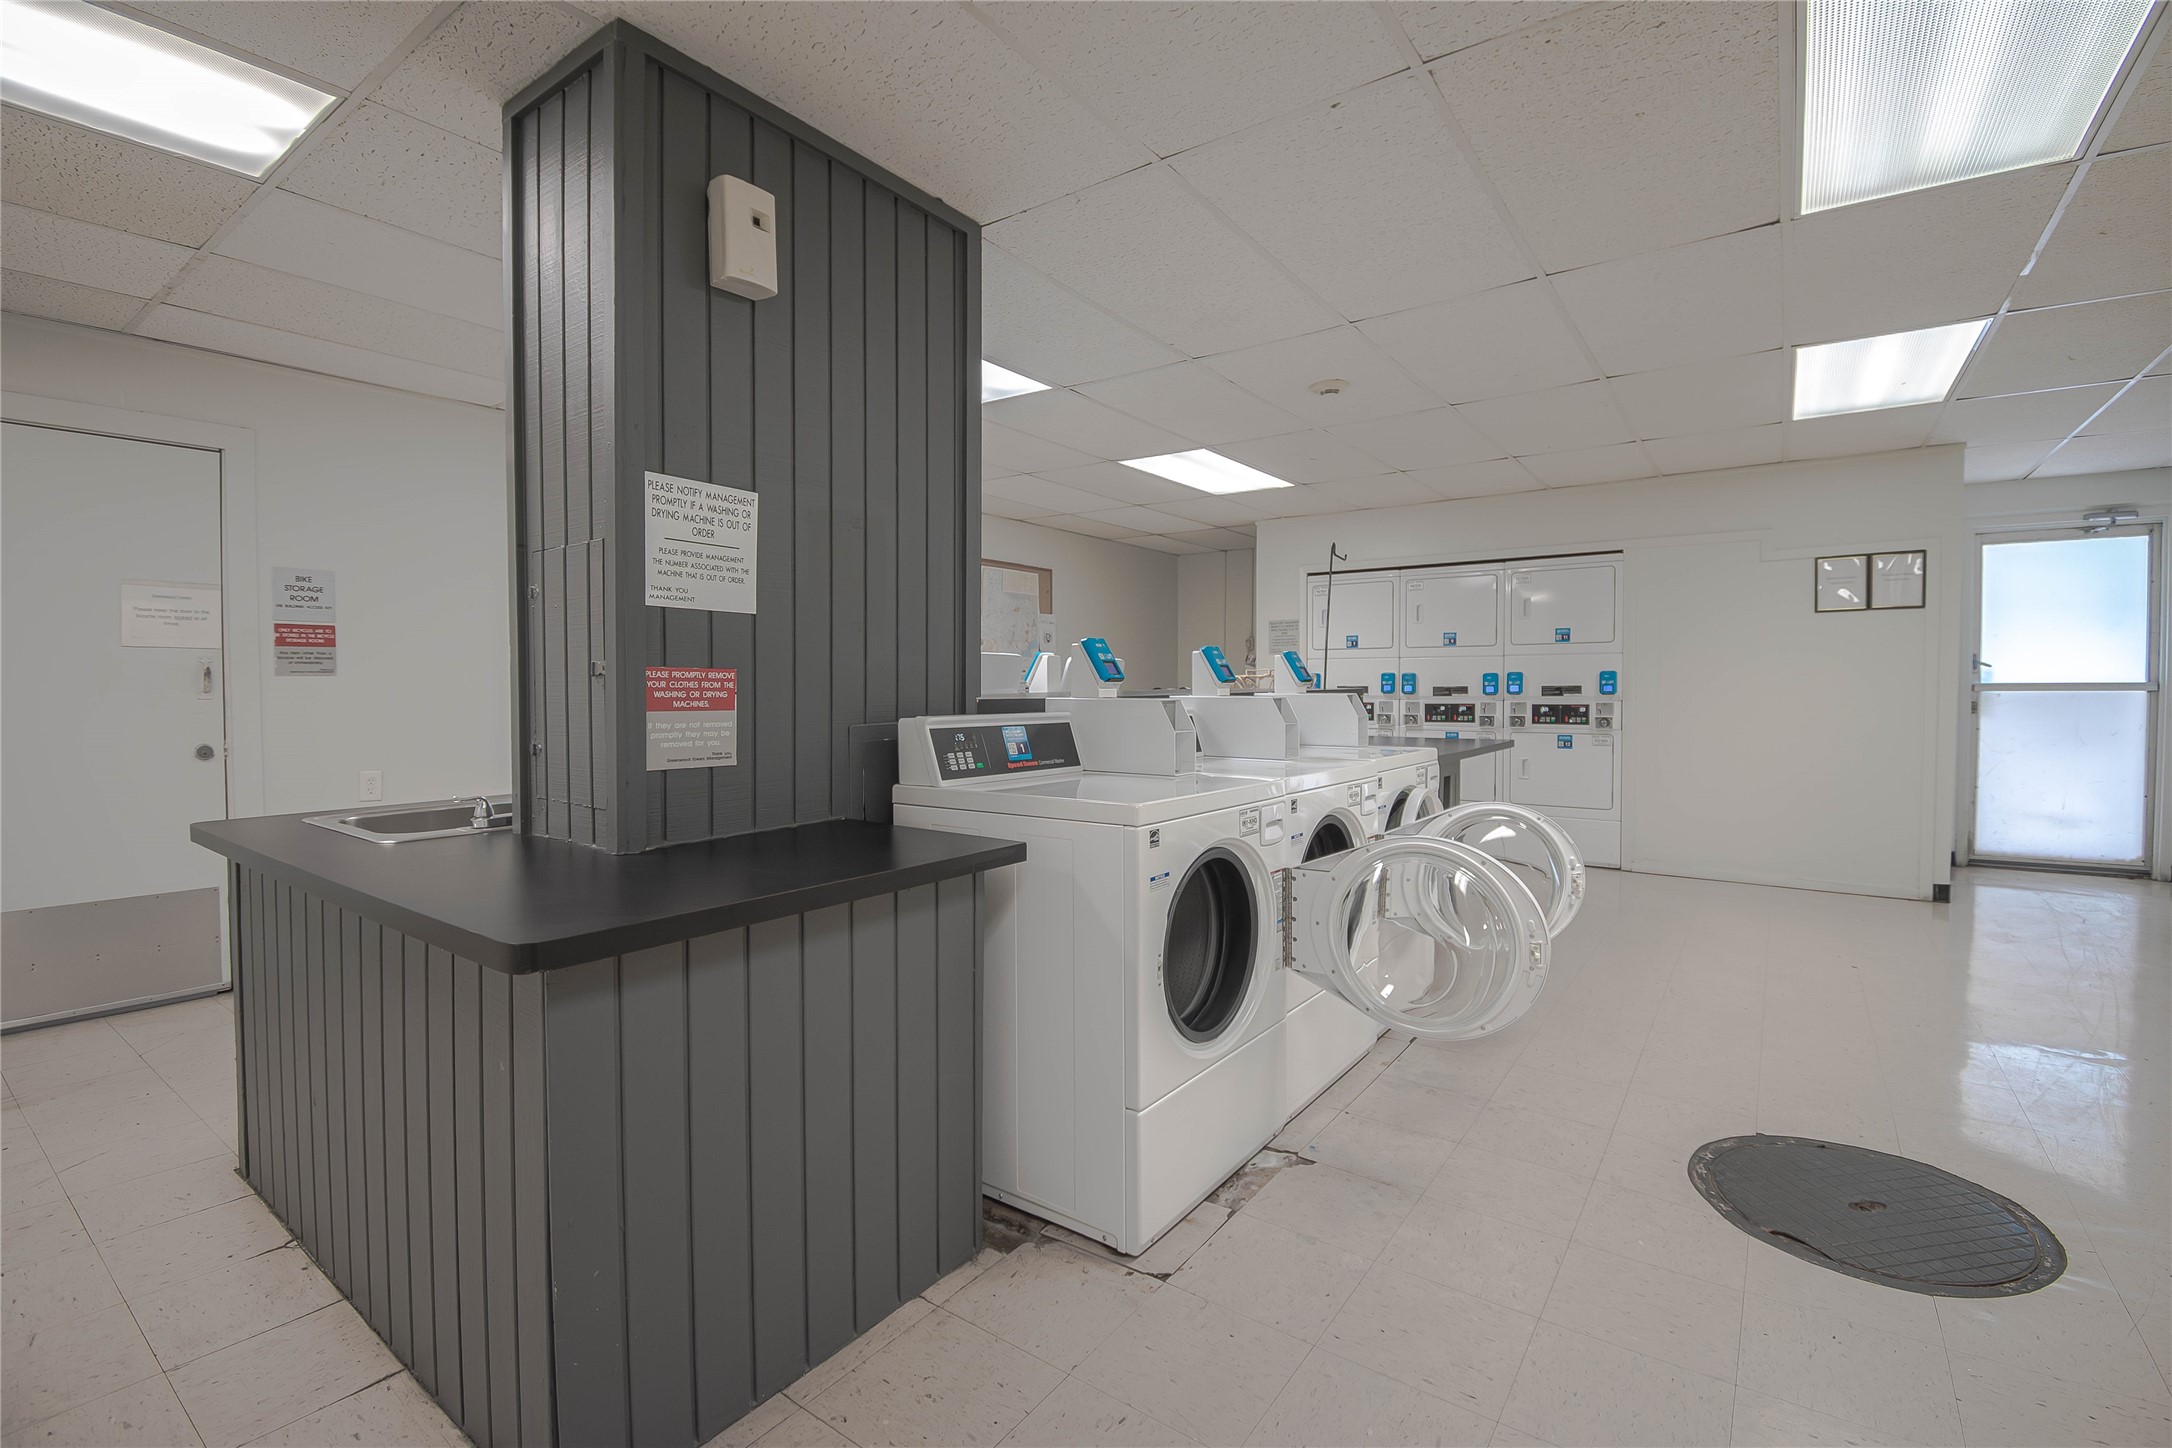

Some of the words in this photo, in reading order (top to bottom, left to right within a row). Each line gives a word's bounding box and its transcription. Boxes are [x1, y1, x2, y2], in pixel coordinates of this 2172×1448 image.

[648, 480, 674, 492] PLEASE
[677, 486, 702, 498] NOTIFY
[705, 492, 755, 508] MANAGEMENT
[652, 494, 687, 508] PROMPTLY
[690, 501, 695, 510] IF
[706, 504, 739, 517] WASHING
[742, 510, 751, 519] OR
[652, 508, 679, 520] DRYING
[683, 514, 715, 526] MACHINE
[718, 519, 724, 527] IS
[727, 520, 739, 530] OUT
[742, 522, 751, 531] OF
[692, 528, 715, 538] ORDER
[658, 547, 678, 556] PLEASE
[681, 550, 703, 559] PROVIDE
[706, 554, 744, 564] MANAGEMENT
[665, 559, 688, 568] NUMBER
[691, 563, 723, 572] ASSOCIATED
[657, 570, 683, 578] MACHINE
[284, 585, 324, 593] STORAGE
[649, 594, 695, 602] MANAGEMENT
[655, 722, 671, 730] they
[650, 732, 682, 740] promptly
[661, 740, 692, 748] removed
[1020, 744, 1025, 752] 1
